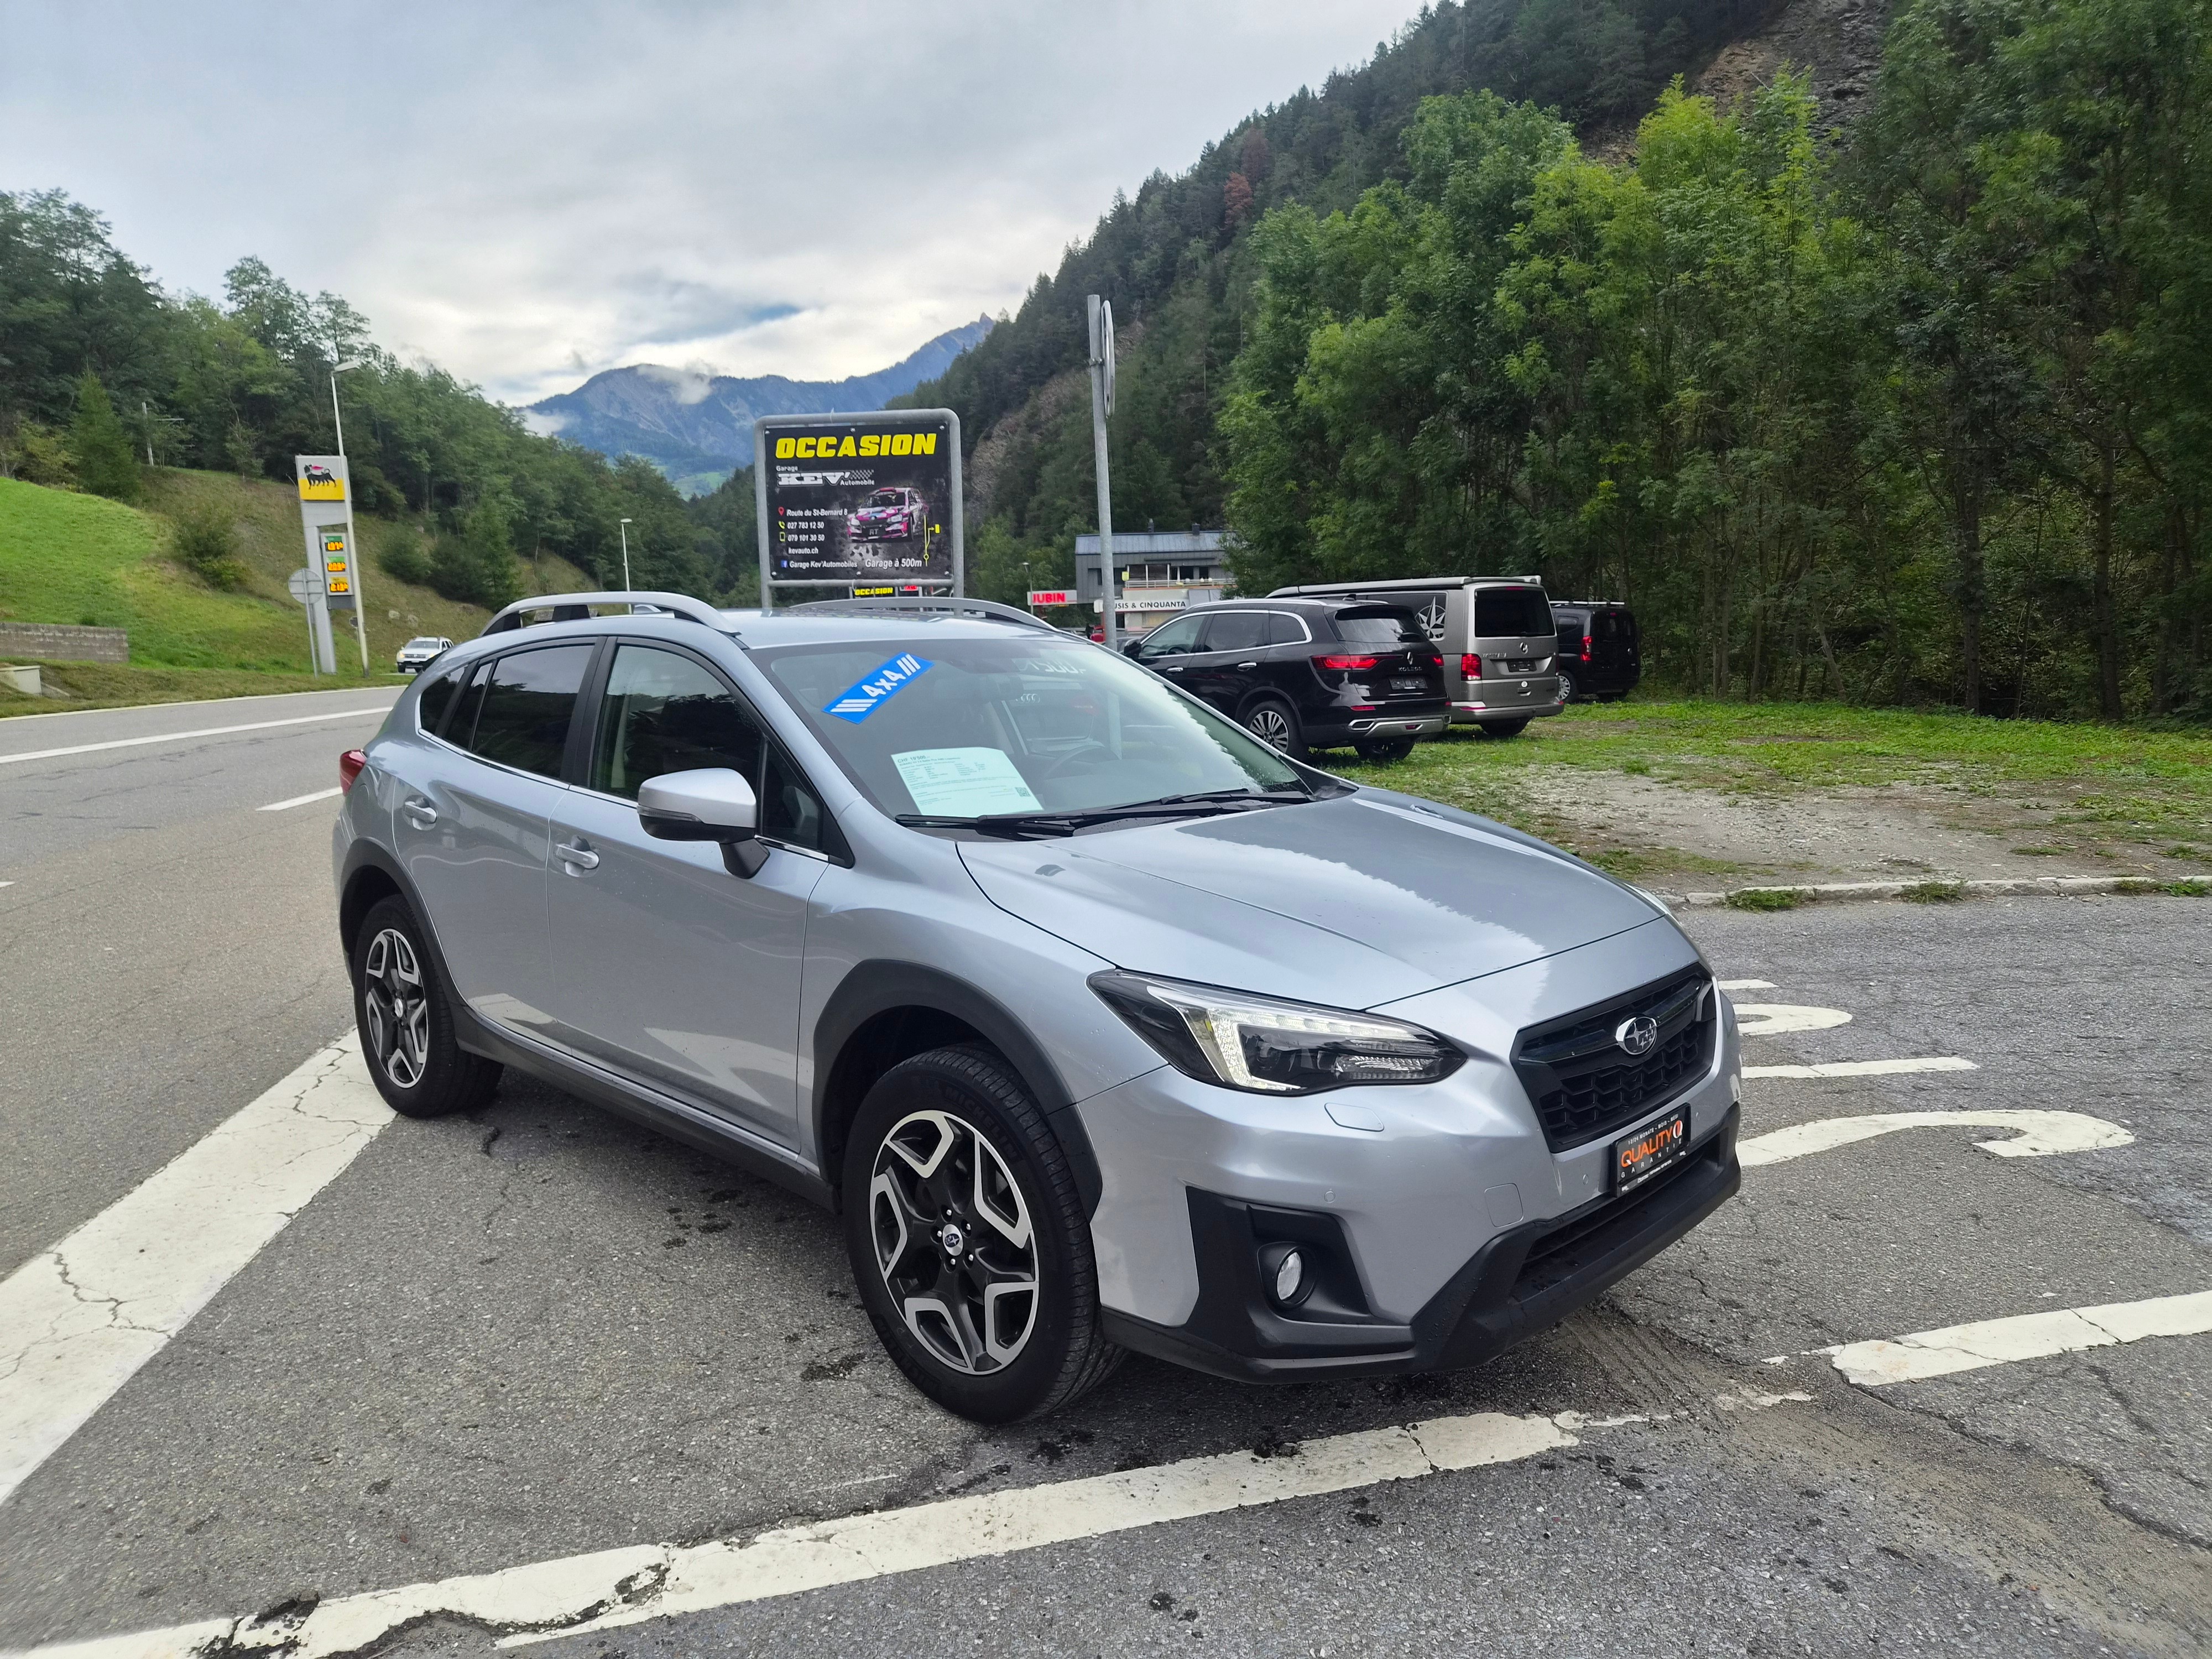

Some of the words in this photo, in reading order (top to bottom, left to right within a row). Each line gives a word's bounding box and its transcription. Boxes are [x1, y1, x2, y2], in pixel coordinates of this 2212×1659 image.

[775, 433, 937, 458] OCCASION
[789, 560, 810, 569] Garage
[865, 559, 893, 570] Garage
[894, 558, 900, 567] à
[901, 558, 922, 567] 500m
[854, 587, 894, 596] OCCASION
[862, 670, 906, 697] 4x4
